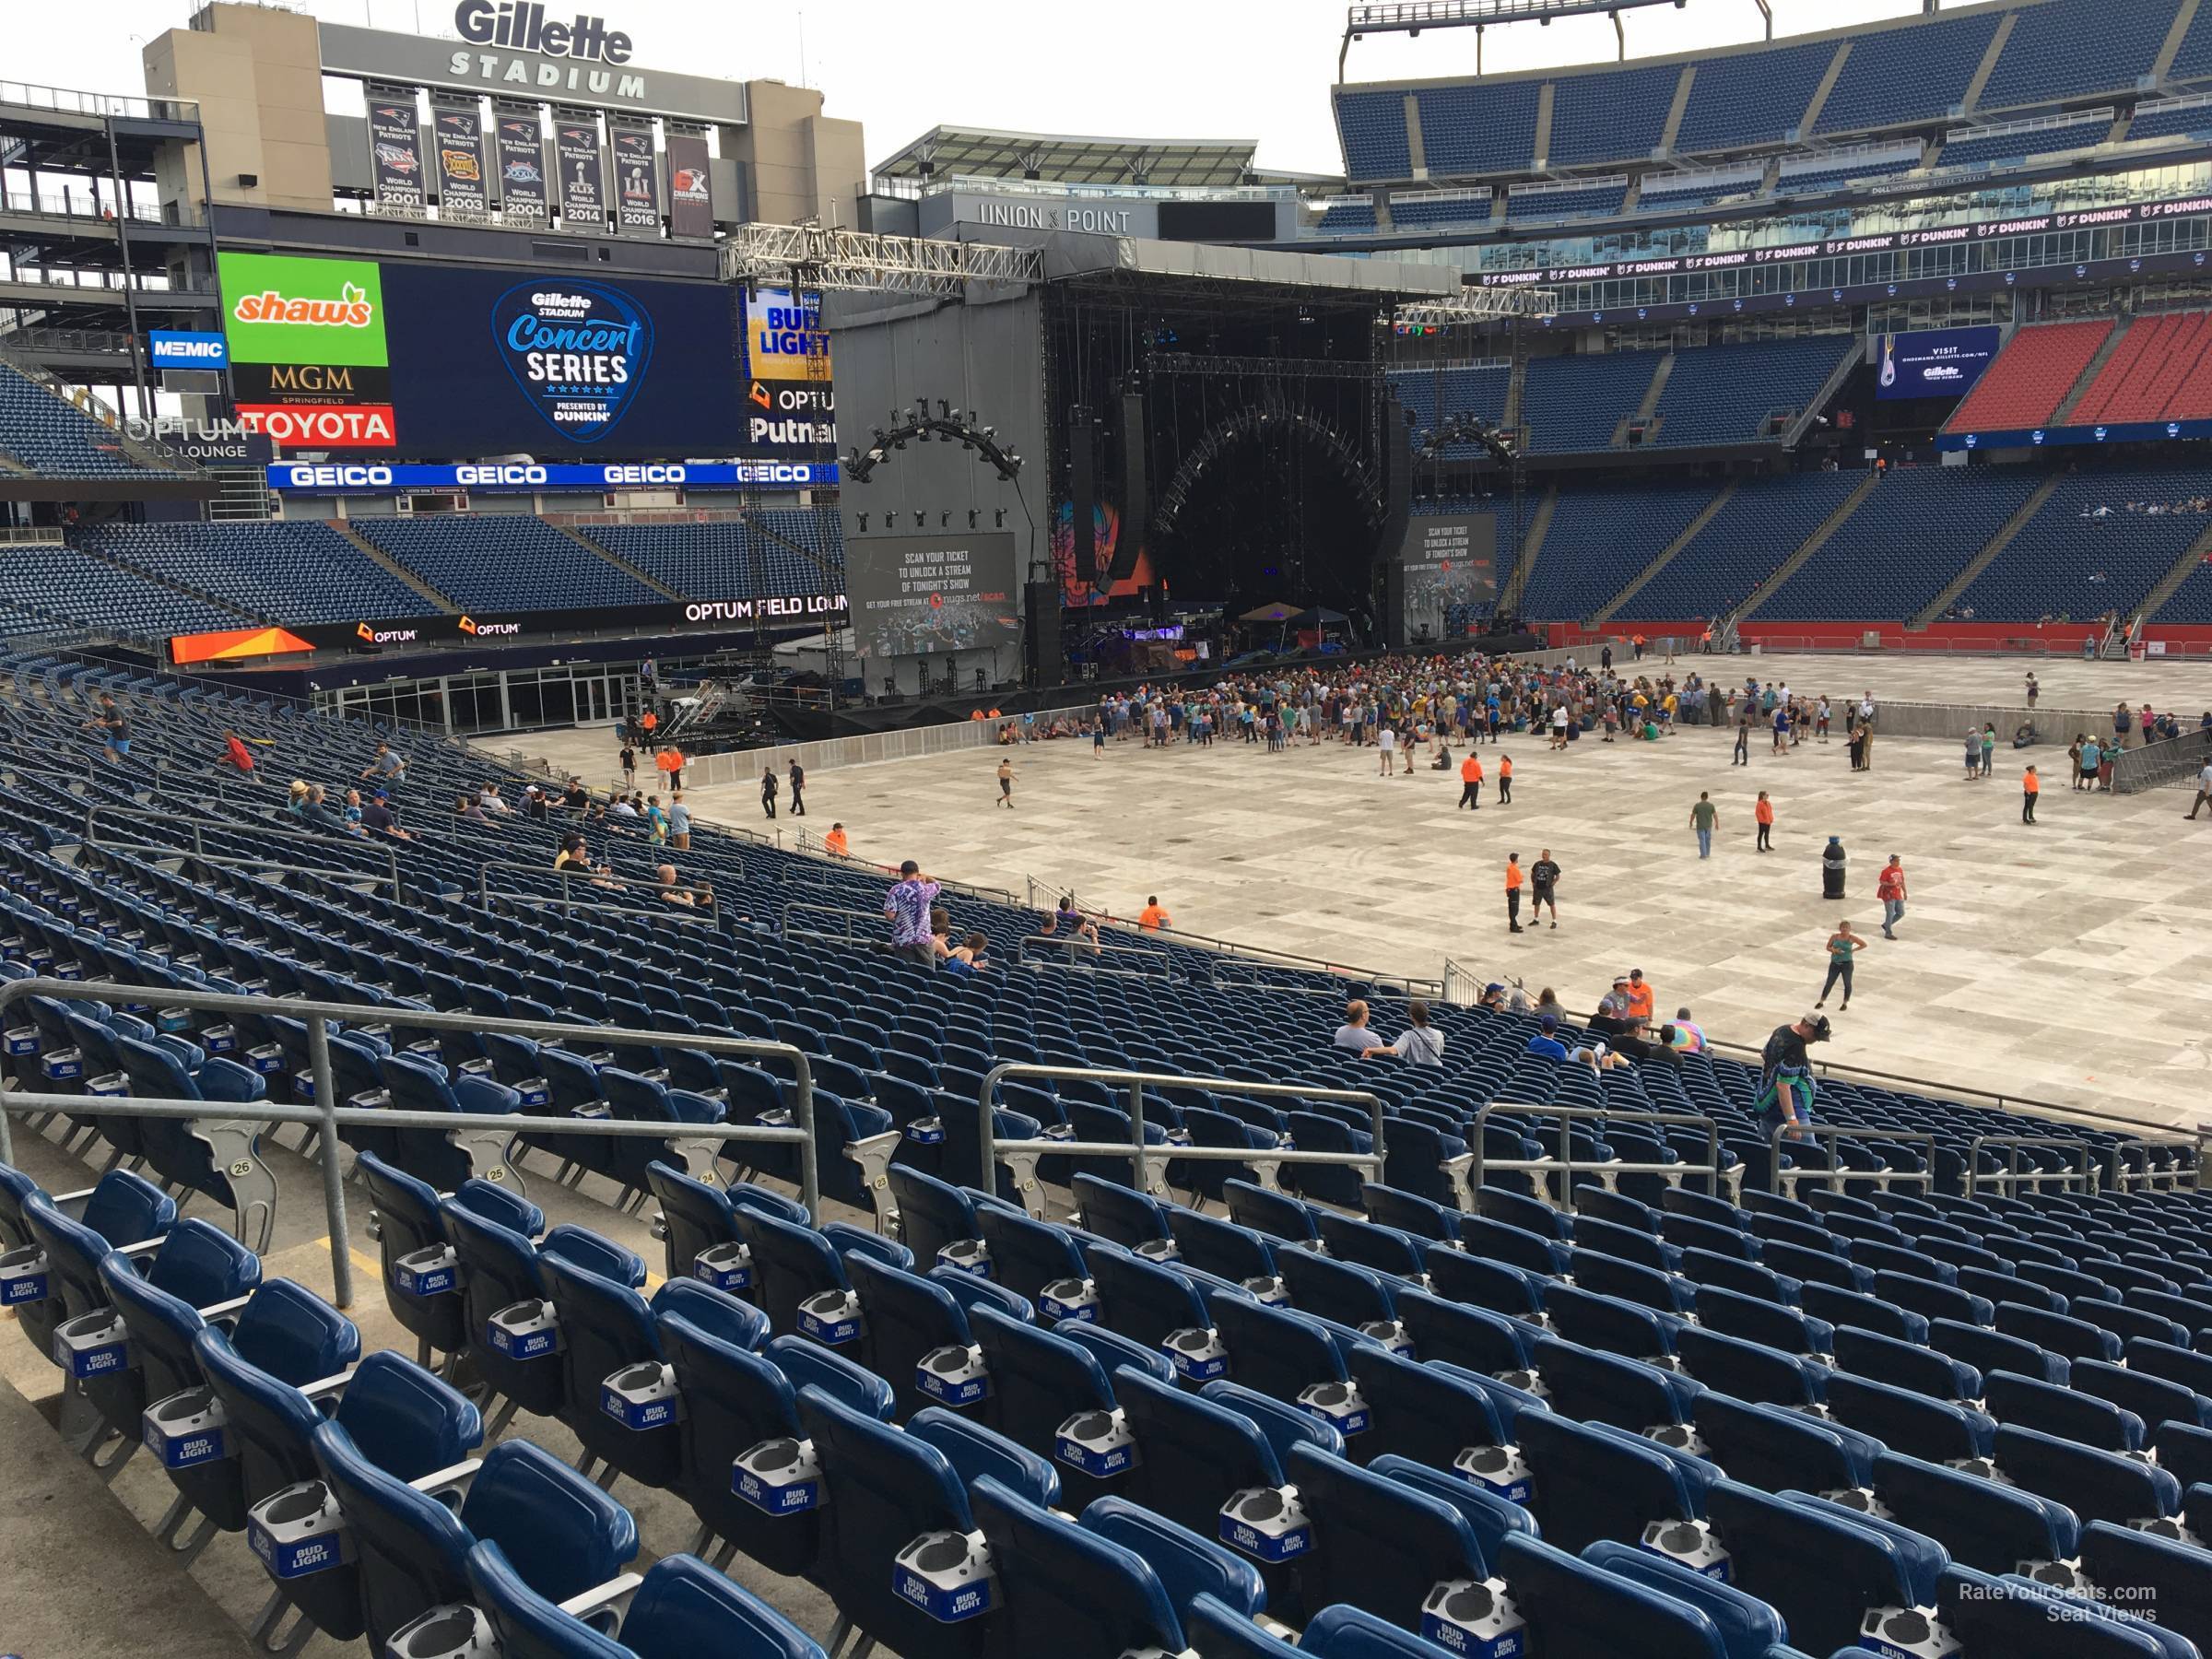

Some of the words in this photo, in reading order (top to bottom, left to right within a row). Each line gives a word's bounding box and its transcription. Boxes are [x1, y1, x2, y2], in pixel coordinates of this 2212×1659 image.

[454, 0, 632, 65] Gillette
[449, 52, 644, 99] STADIUM
[569, 184, 595, 194] XLIX
[382, 193, 420, 205] 2001
[445, 197, 484, 210] 2003
[507, 204, 545, 217] 2004
[568, 209, 600, 222] 2014
[2079, 209, 2132, 224] DUNKIN'
[624, 214, 655, 225] 2016
[979, 203, 1042, 229] UNION
[1066, 209, 1131, 232] POINT
[1998, 218, 2049, 233] DUNKIN'
[1920, 228, 1970, 242] DUNKIN'
[1846, 236, 1893, 251] DUNKIN'
[1774, 245, 1819, 259] DUNKIN'
[1635, 259, 1679, 273] DUNKIN'
[1705, 253, 1748, 266] DUNKIN'
[1500, 272, 1543, 284] DUNKIN'
[1568, 266, 1610, 278] DUNKIN'
[532, 292, 592, 309] Gillette
[538, 308, 585, 318] STADIUM
[767, 307, 820, 331] BUD
[507, 314, 641, 356] Concert
[155, 341, 223, 358] MEMIC
[760, 331, 830, 356] LIGHT
[1933, 347, 1959, 355] VISIT
[526, 352, 629, 383] SERIES
[1923, 367, 1959, 377] Gillette
[270, 366, 354, 391] MGM
[282, 397, 345, 406] SPRINGFIELD
[557, 402, 596, 411] PRESENTED
[598, 403, 607, 411] BY
[126, 417, 247, 441] OPTUM
[241, 412, 391, 440] TOYOTA
[180, 445, 247, 458] LOUNGE
[290, 466, 393, 486] GEICO
[456, 465, 547, 484] GEICO
[604, 465, 686, 483] GEICO
[736, 465, 810, 482] GEICO
[1453, 525, 1467, 535] TICKET
[1424, 539, 1430, 547] TO
[1448, 537, 1452, 547] A
[1453, 537, 1469, 546] STREAM
[905, 552, 924, 564] SCAN
[925, 551, 945, 563] YOUR
[946, 550, 969, 561] TICKET
[899, 568, 908, 579] TO
[910, 567, 937, 578] UNLOCK
[938, 566, 944, 577] A
[945, 564, 971, 576] STREAM
[901, 582, 912, 593] OF
[912, 580, 948, 592] TONIGHT'S
[949, 579, 970, 589] SHOW
[686, 601, 751, 621] OPTUM
[758, 596, 802, 616] FIELD
[877, 600, 890, 608] YOUR
[891, 600, 902, 608] FREE
[903, 598, 922, 607] STREAM
[477, 623, 519, 636] OPTUM
[374, 630, 416, 643] OPTUM
[235, 1161, 250, 1173] 26
[489, 1169, 503, 1180] 25
[701, 1173, 714, 1183] 24
[877, 1177, 887, 1187] 23
[1025, 1180, 1034, 1189] 22
[1156, 1183, 1164, 1193] 21
[12, 1282, 34, 1291] BUD
[426, 1279, 449, 1290] LIGHT
[428, 1275, 445, 1285] BUD
[9, 1287, 39, 1298] LIGHT
[524, 1340, 548, 1352] LIGHT
[527, 1336, 546, 1347] BUD
[86, 1358, 117, 1371] LIGHT
[89, 1352, 112, 1364] BUD
[960, 1388, 981, 1398] LIGHT
[963, 1383, 979, 1394] BUD
[641, 1409, 668, 1423] LIGHT
[645, 1405, 665, 1417] BUD
[183, 1438, 208, 1451] BUD
[1067, 1443, 1082, 1454] BUD
[180, 1445, 213, 1460] LIGHT
[1064, 1448, 1086, 1465] LIGHT
[1107, 1452, 1123, 1462] BUD
[1104, 1456, 1125, 1469] LIGHT
[743, 1474, 759, 1489] BUD
[1467, 1475, 1486, 1488] BUD
[740, 1481, 760, 1501] LIGHT
[785, 1489, 806, 1500] BUD
[782, 1494, 809, 1507] LIGHT
[1236, 1524, 1256, 1540] BUD
[1233, 1532, 1259, 1550] LIGHT
[1281, 1540, 1304, 1554] LIGHT
[1284, 1535, 1300, 1547] BUD
[296, 1545, 324, 1559] BUD
[292, 1551, 328, 1569] LIGHT
[906, 1575, 925, 1594] BUD
[903, 1583, 929, 1606] LIGHT
[956, 1591, 977, 1606] BUD
[952, 1596, 981, 1614] LIGHT
[1441, 1622, 1464, 1641] BUD
[1436, 1630, 1467, 1652] LIGHT
[1497, 1637, 1514, 1650] BUD
[1493, 1642, 1516, 1659] LIGHT
